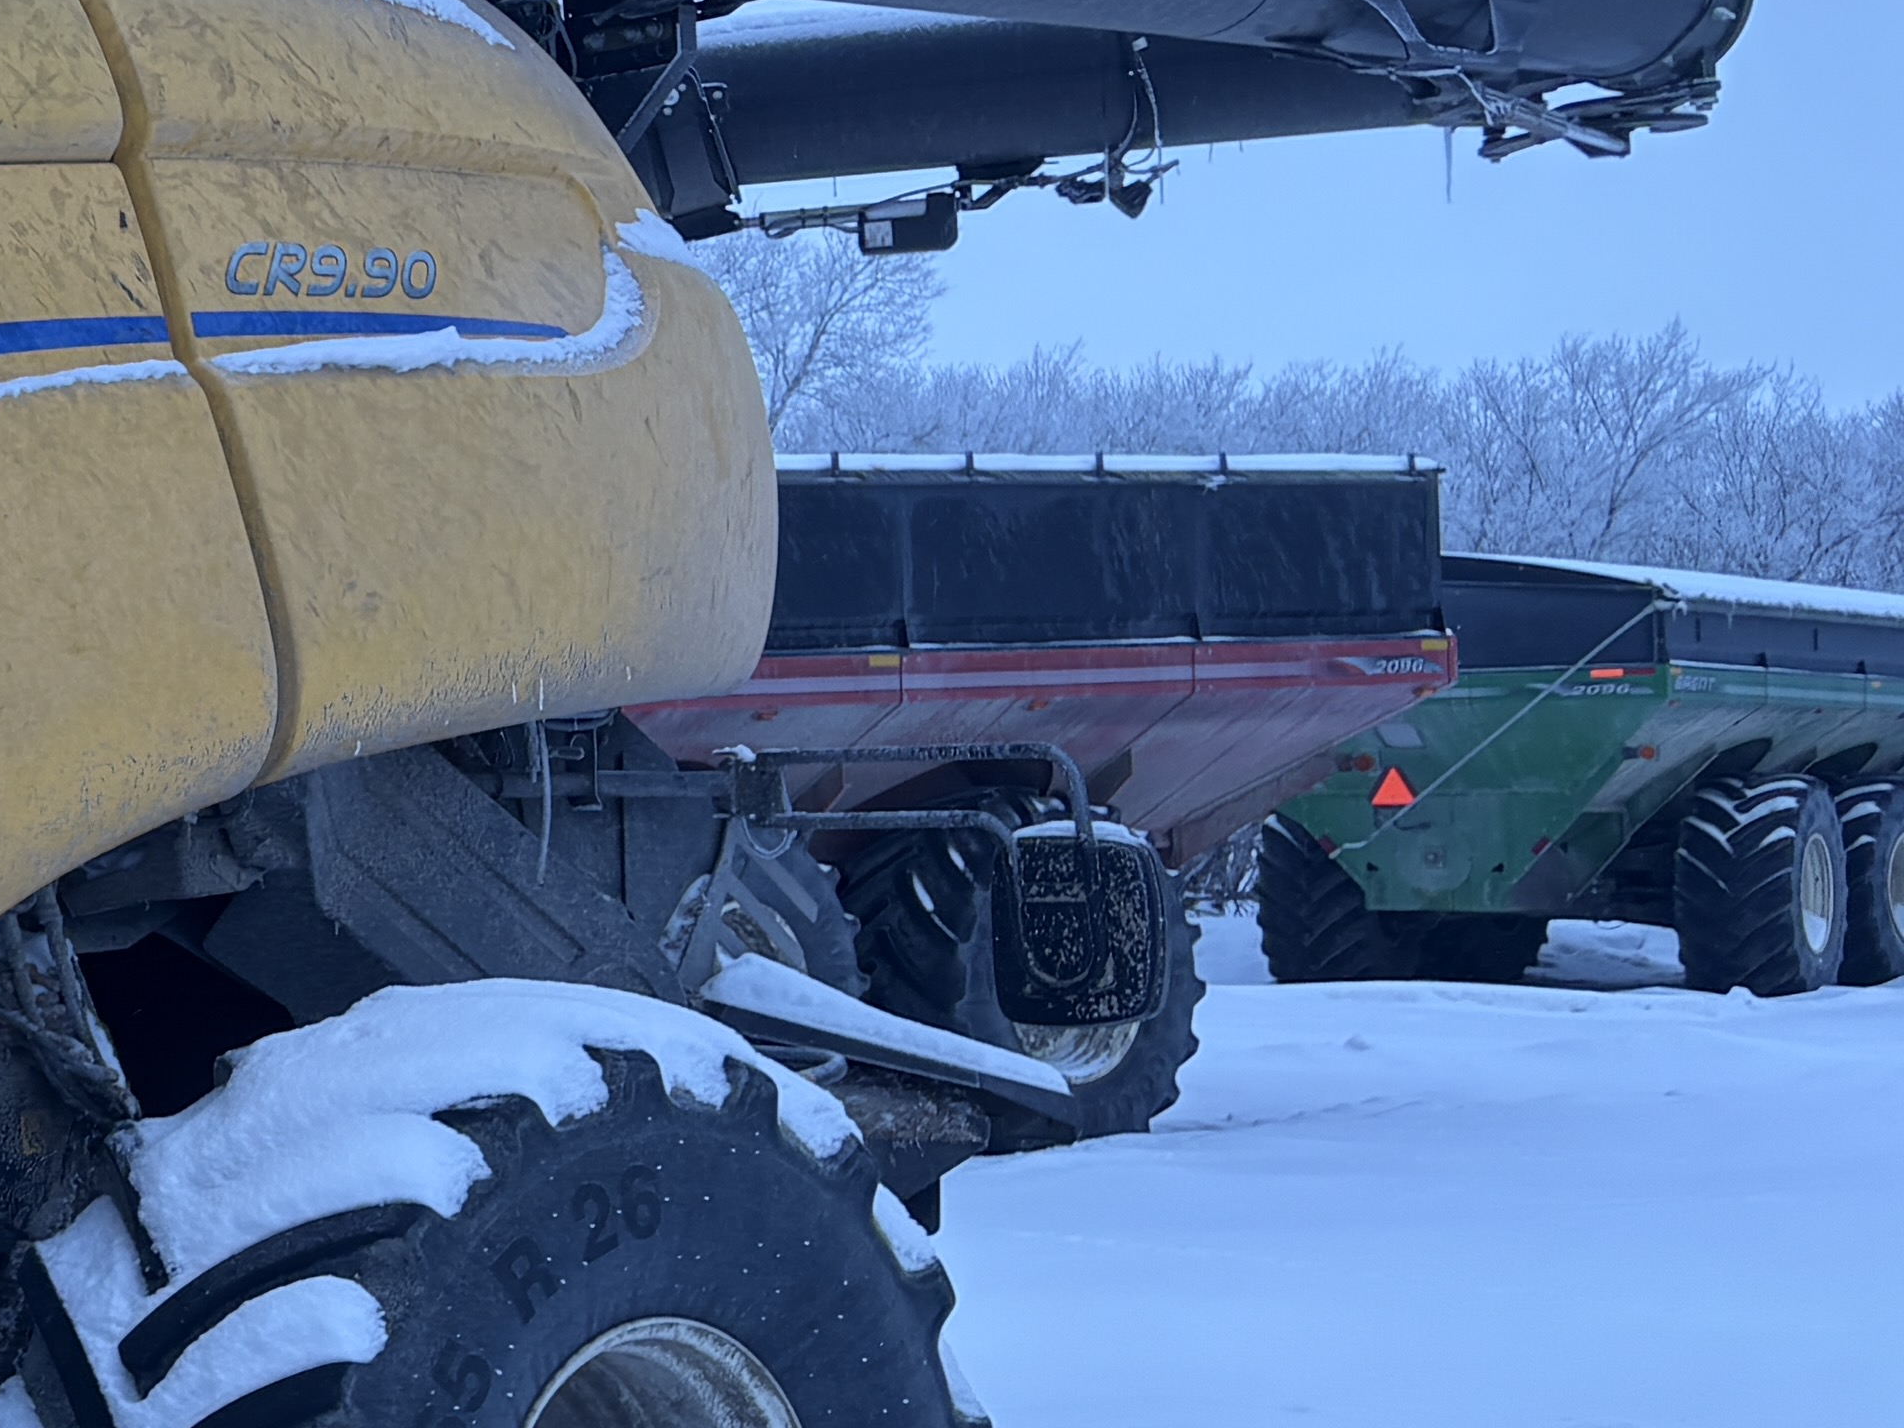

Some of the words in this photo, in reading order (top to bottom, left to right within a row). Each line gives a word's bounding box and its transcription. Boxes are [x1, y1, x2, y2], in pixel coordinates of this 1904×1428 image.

[224, 240, 438, 300] CR9.90
[490, 1232, 564, 1327] R
[568, 1163, 664, 1266] 26
